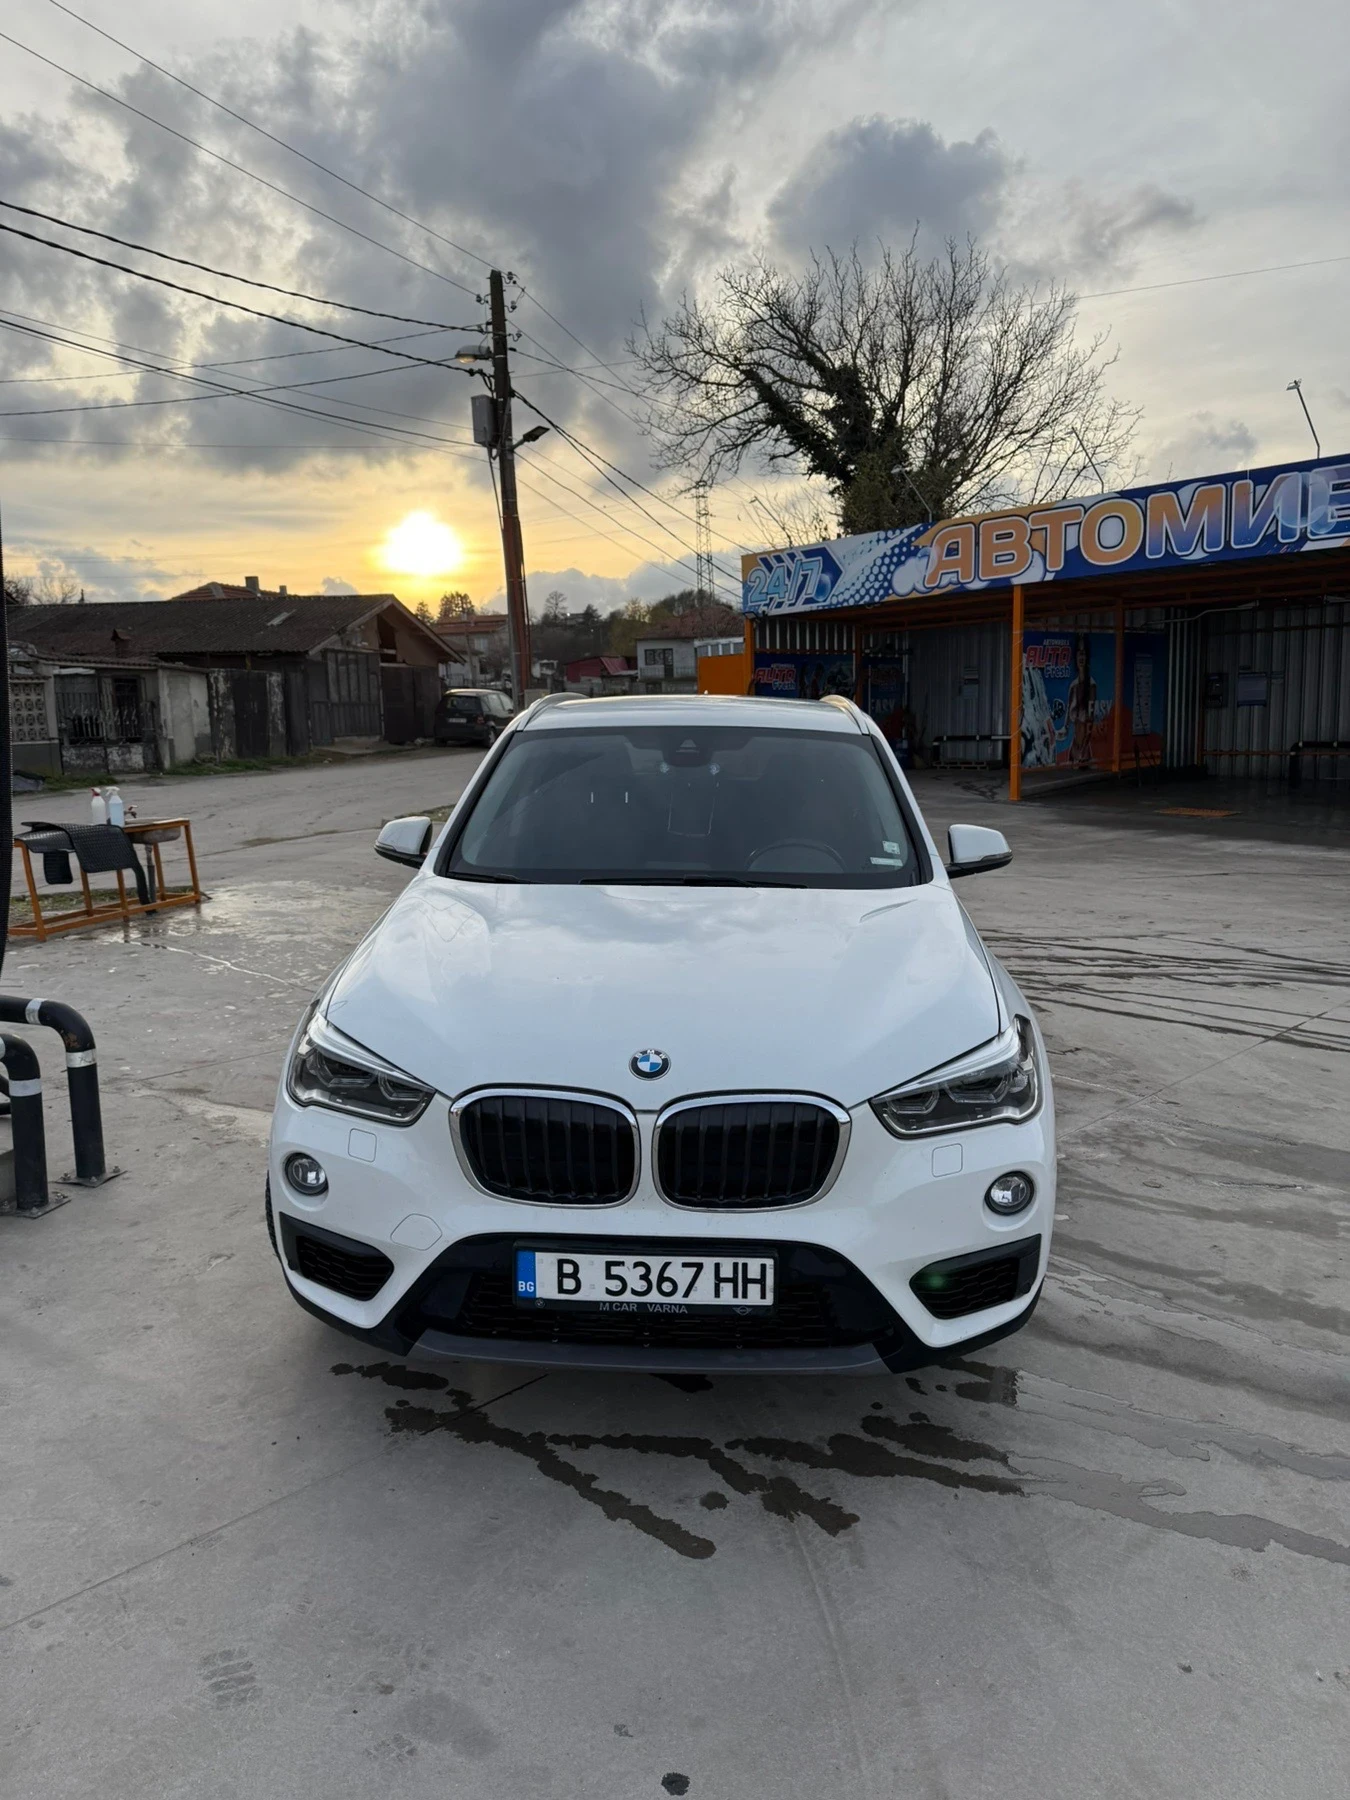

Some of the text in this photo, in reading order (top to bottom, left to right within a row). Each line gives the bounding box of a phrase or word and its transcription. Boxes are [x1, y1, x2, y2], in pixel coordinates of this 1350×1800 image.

[748, 556, 823, 604] 24/7
[1026, 645, 1071, 668] AUTO
[1044, 664, 1070, 678] Fresh
[518, 1281, 535, 1293] BG
[604, 1260, 704, 1298] 5367
[612, 1302, 638, 1312] CAR
[647, 1303, 688, 1314] VARNA
